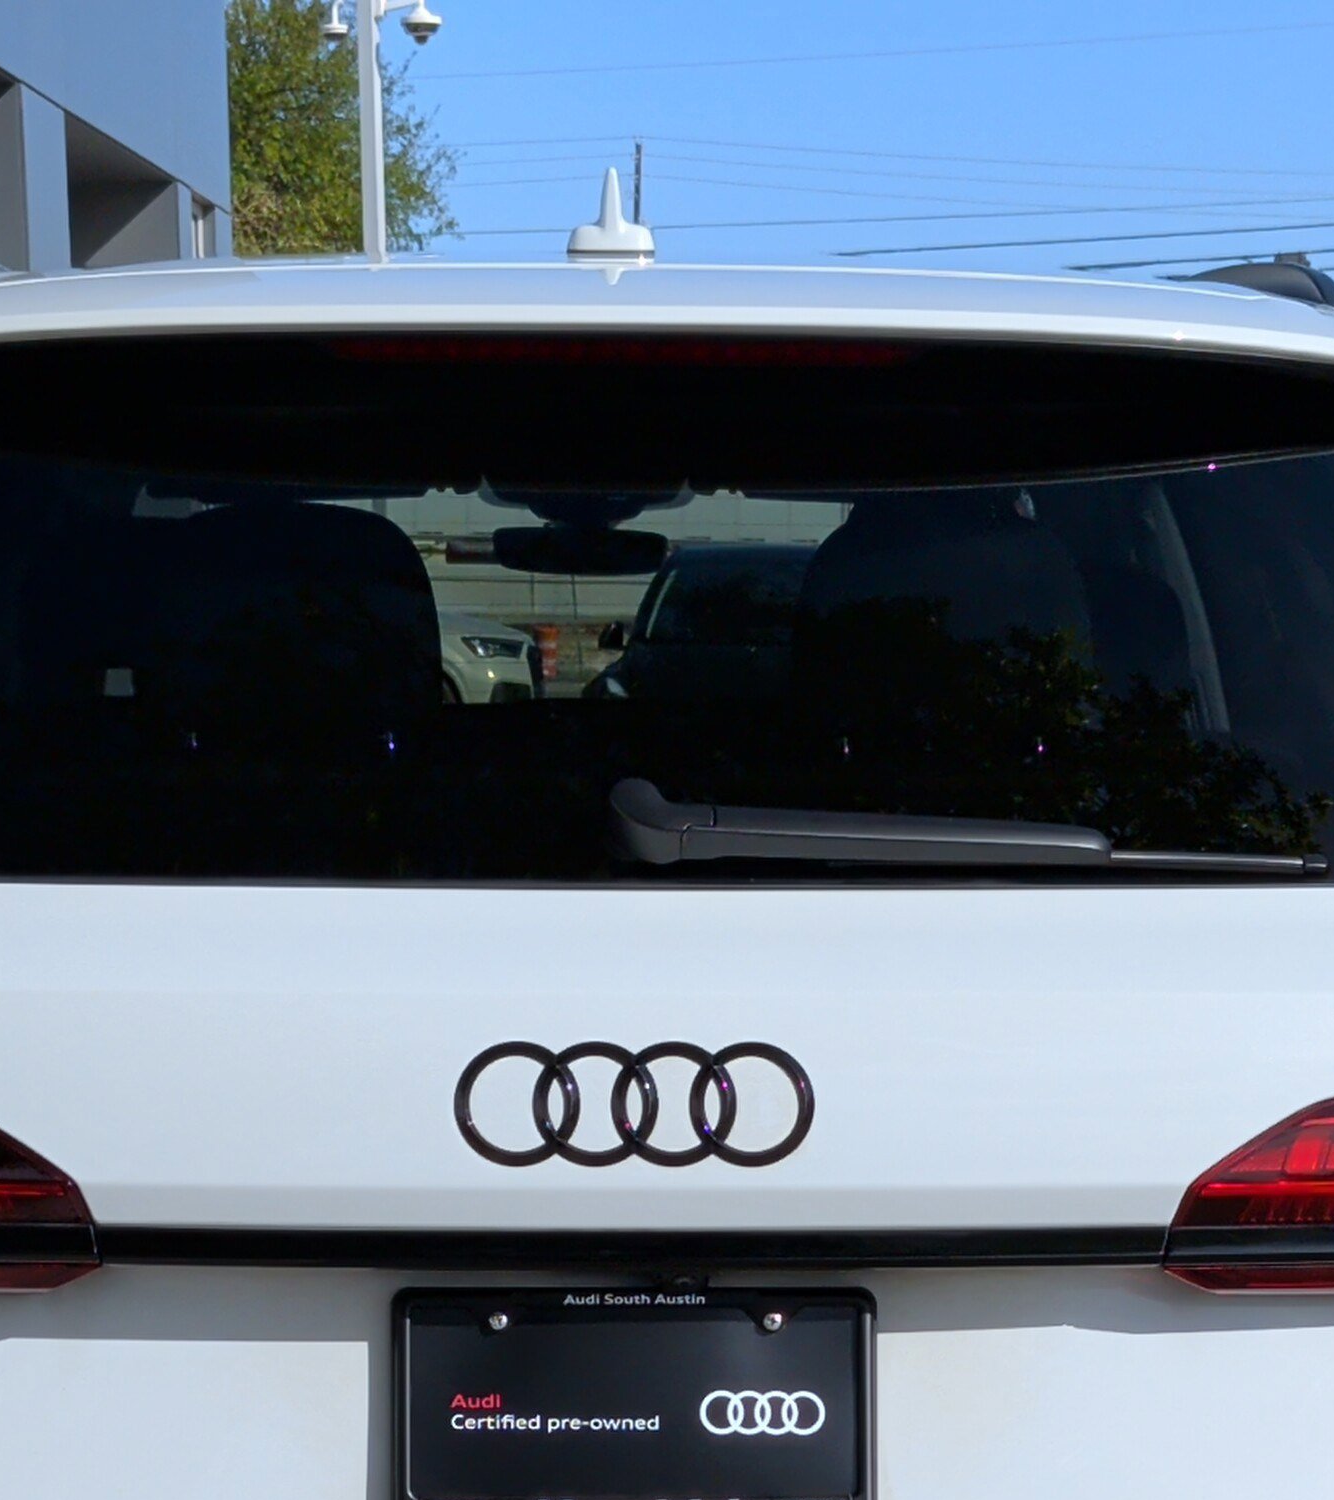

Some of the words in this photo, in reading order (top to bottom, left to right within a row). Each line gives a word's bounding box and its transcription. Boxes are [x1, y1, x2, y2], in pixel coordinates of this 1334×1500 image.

[563, 1293, 601, 1306] Audi
[604, 1293, 650, 1306] South
[654, 1293, 706, 1306] Austin
[451, 1393, 501, 1409] Audi
[451, 1414, 541, 1430] Certified
[547, 1415, 660, 1433] pre-owned
